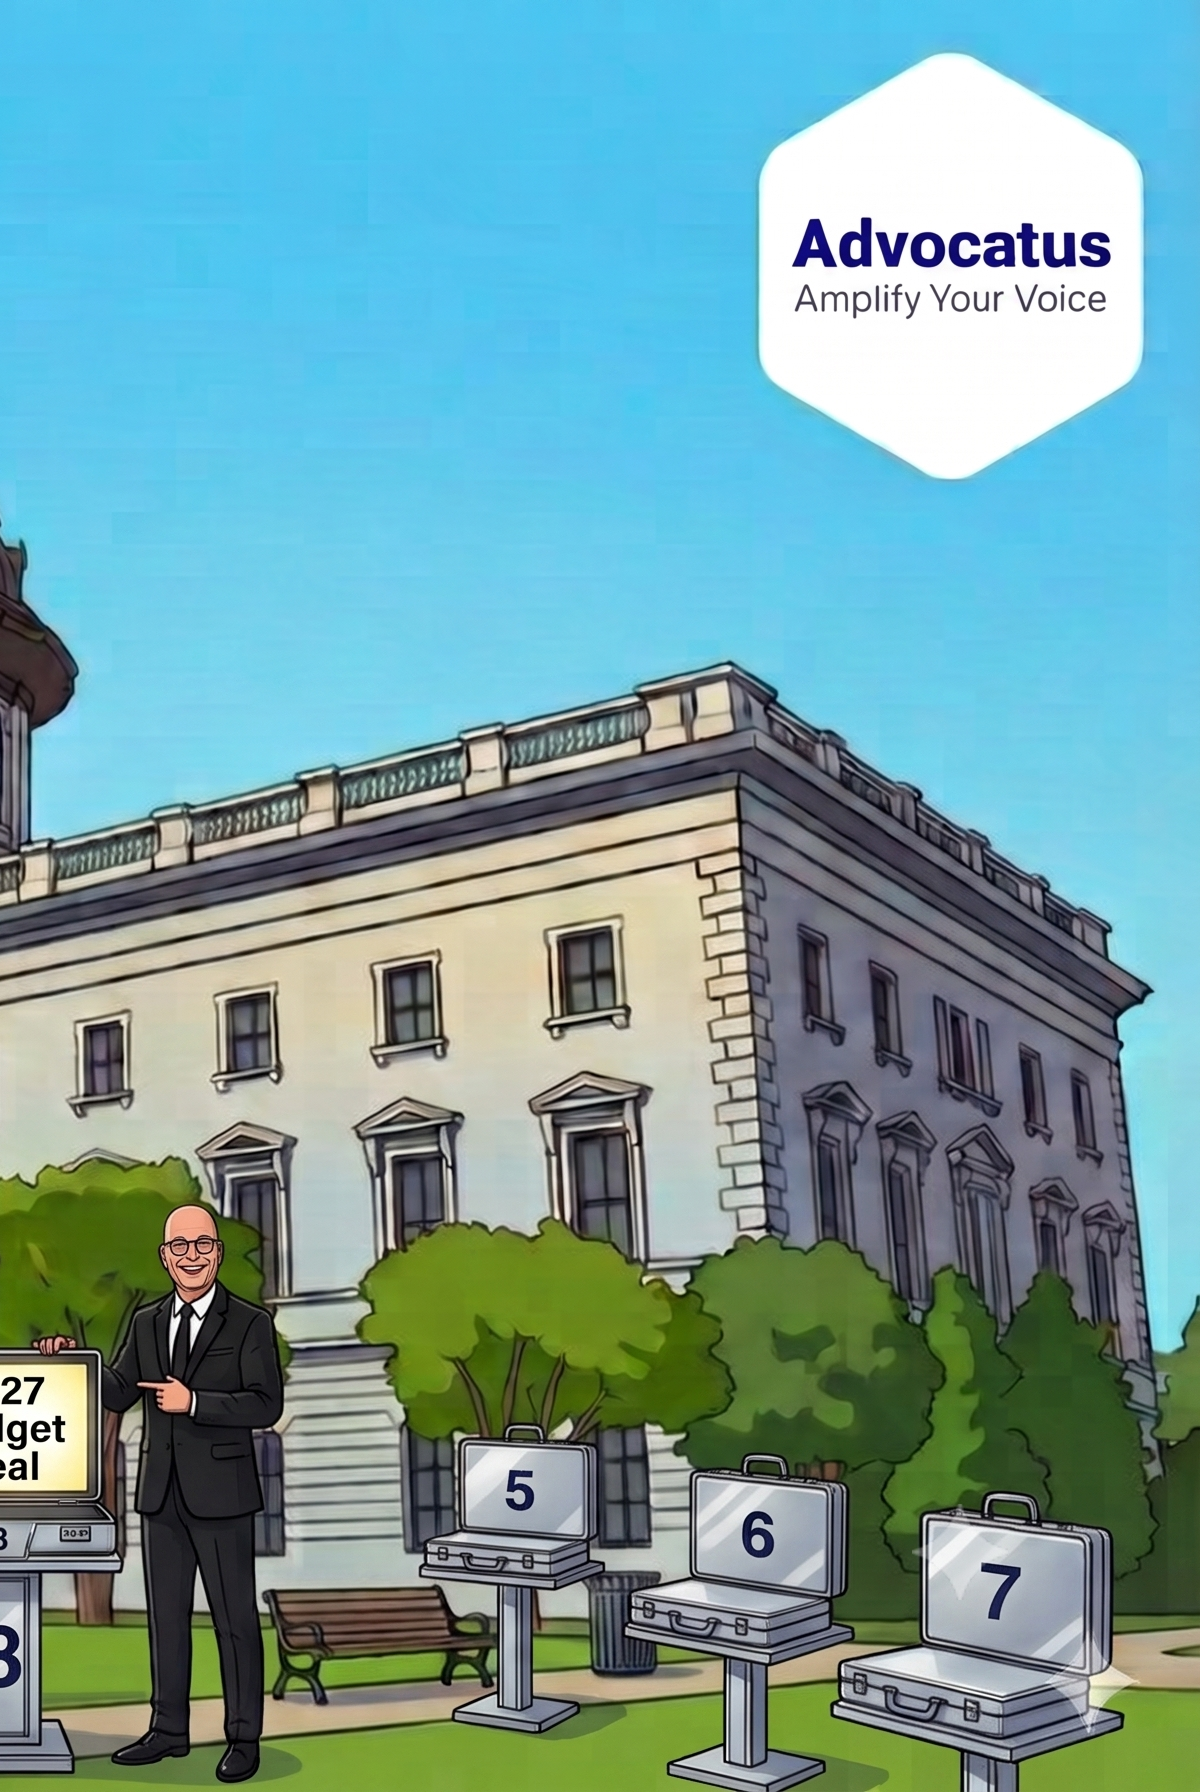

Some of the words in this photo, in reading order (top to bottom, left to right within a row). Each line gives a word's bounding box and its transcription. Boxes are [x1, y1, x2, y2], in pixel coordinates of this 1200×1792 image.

[505, 1469, 535, 1512] 5
[741, 1510, 775, 1559] 6
[980, 1562, 1022, 1621] 7
